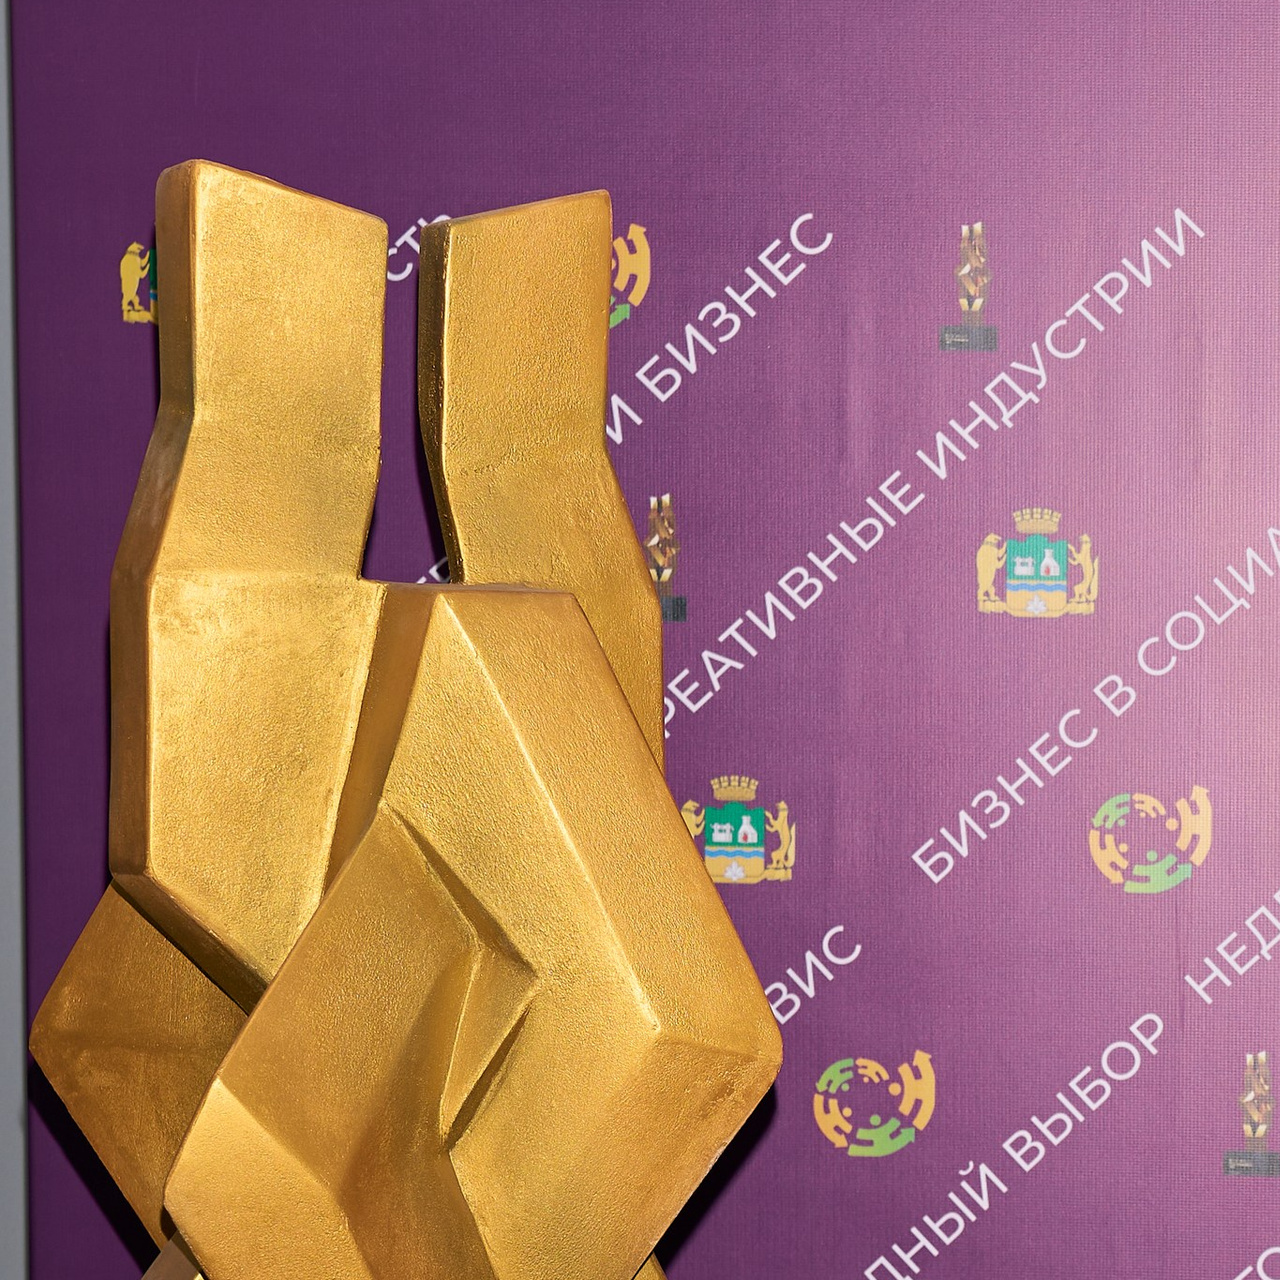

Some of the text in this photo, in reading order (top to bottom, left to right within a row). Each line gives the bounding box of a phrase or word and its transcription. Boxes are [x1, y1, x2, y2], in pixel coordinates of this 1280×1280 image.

[606, 212, 833, 447] И БИЗНЕС
[665, 208, 1205, 738] ЕАТИВНЫЕ ИНДУСТРИИ
[911, 708, 1098, 884] БИЗНЕС
[1093, 674, 1136, 717] В
[766, 925, 862, 1023] ВИС
[1002, 1013, 1164, 1172] ВЫБОР
